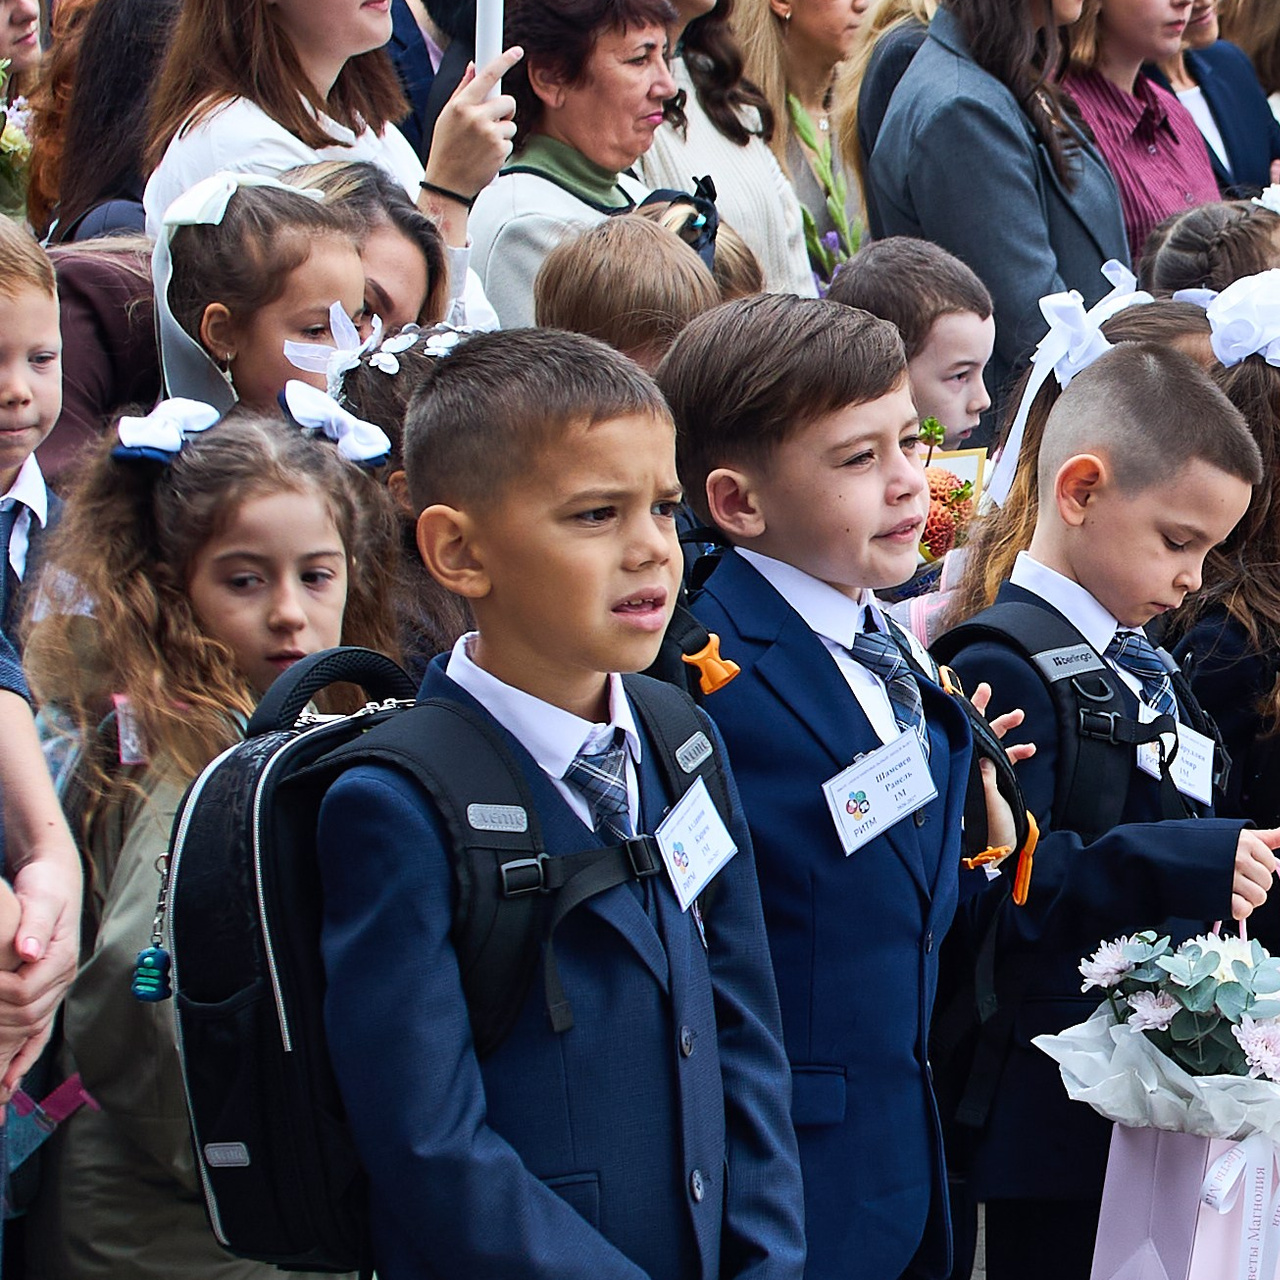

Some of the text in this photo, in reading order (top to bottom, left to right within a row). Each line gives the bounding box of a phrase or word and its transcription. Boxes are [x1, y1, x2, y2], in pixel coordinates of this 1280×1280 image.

[1061, 652, 1093, 665] berlingo
[875, 756, 912, 783] Шамсиев
[853, 816, 878, 838] РИТМ
[1214, 1147, 1245, 1182] Цветы
[1248, 1167, 1265, 1241] Магнолия
